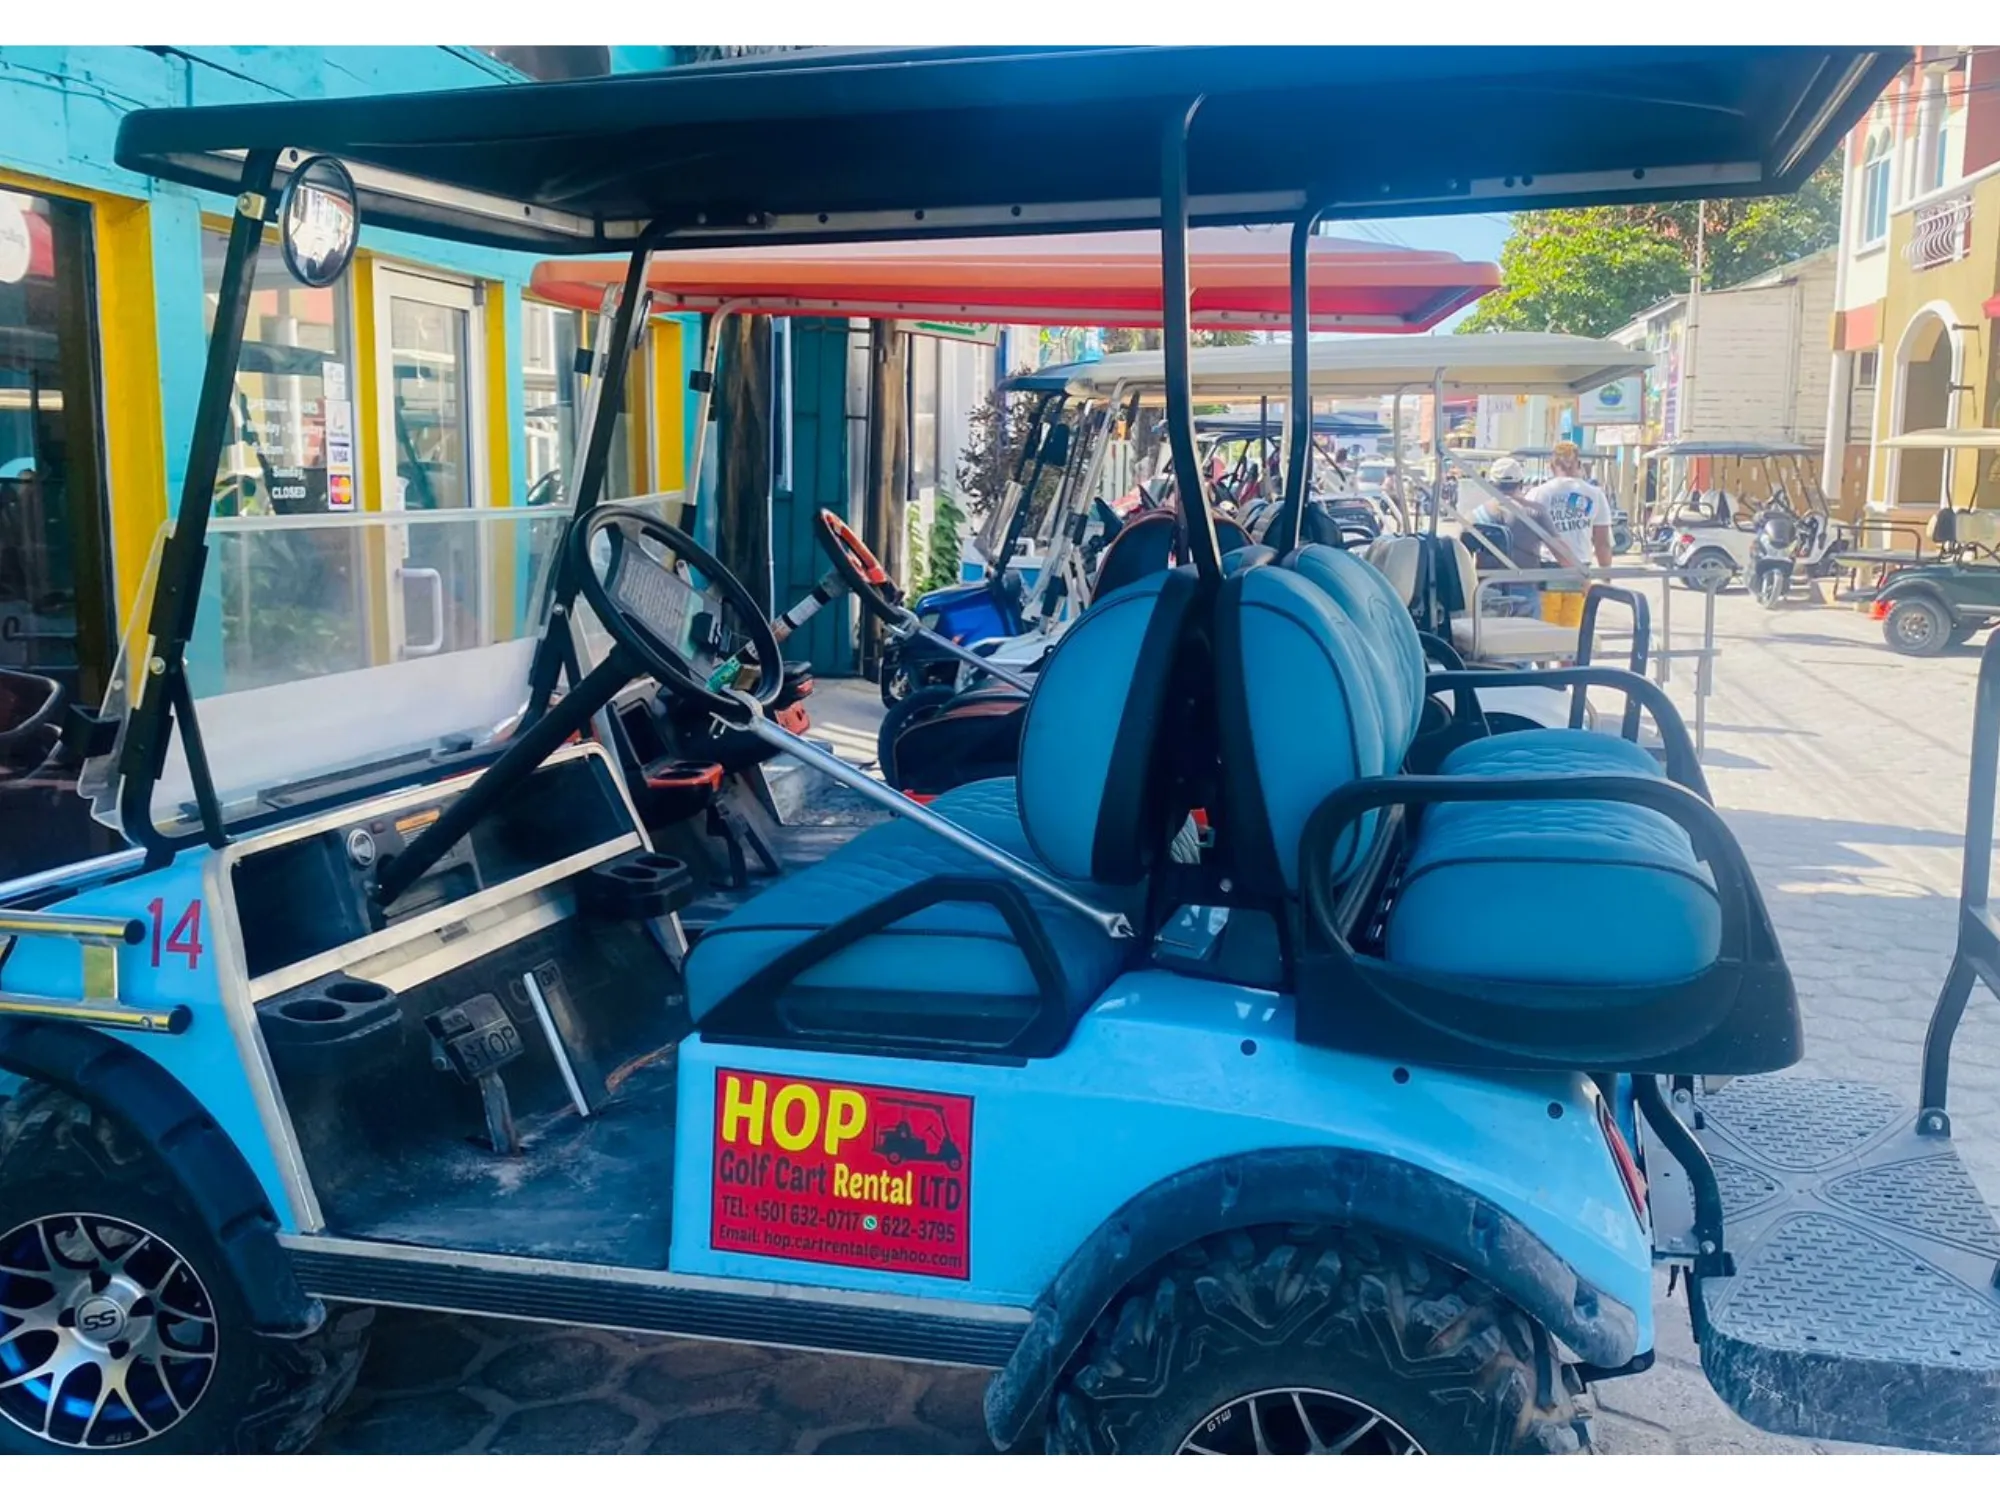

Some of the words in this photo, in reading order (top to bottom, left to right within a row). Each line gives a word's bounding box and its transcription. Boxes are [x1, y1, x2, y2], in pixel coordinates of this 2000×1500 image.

[272, 487, 306, 499] CLOSED
[147, 897, 202, 970] 14
[464, 1025, 516, 1071] STOP
[722, 1076, 867, 1155] HOP
[720, 1150, 770, 1187] Golf
[775, 1157, 827, 1194] Cart
[833, 1163, 913, 1206] Rental
[919, 1176, 962, 1211] LTD
[719, 1224, 760, 1245] Email:
[721, 1195, 748, 1218] TEL:
[754, 1200, 786, 1222] +501
[790, 1203, 861, 1232] 632-0717
[881, 1215, 956, 1243] 622-3795
[84, 1309, 116, 1331] SS
[1207, 1408, 1232, 1432] GTW
